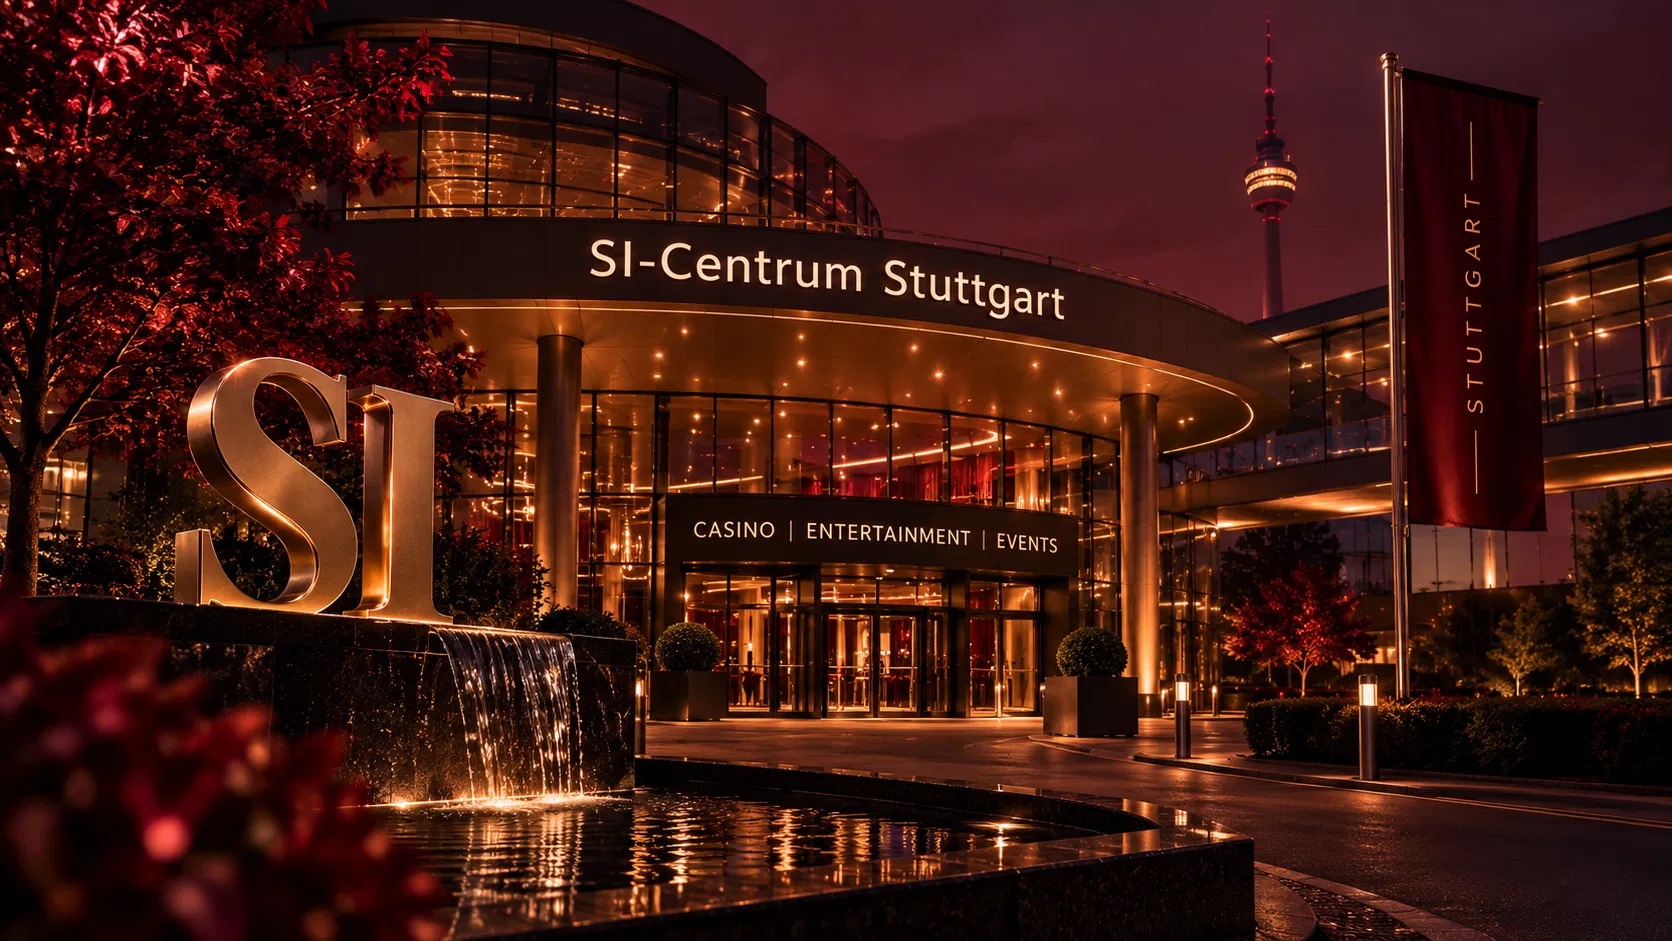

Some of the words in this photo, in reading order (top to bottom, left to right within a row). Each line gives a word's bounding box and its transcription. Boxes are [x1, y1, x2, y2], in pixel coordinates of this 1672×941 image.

[589, 238, 863, 292] SI-Centrum
[884, 259, 1065, 320] Stuttgart
[1463, 193, 1484, 414] STUTTGART
[174, 357, 455, 624] SI
[693, 520, 775, 539] CASINO
[807, 522, 971, 546] ENTERTAINMENT
[997, 532, 1058, 554] EVENTS
